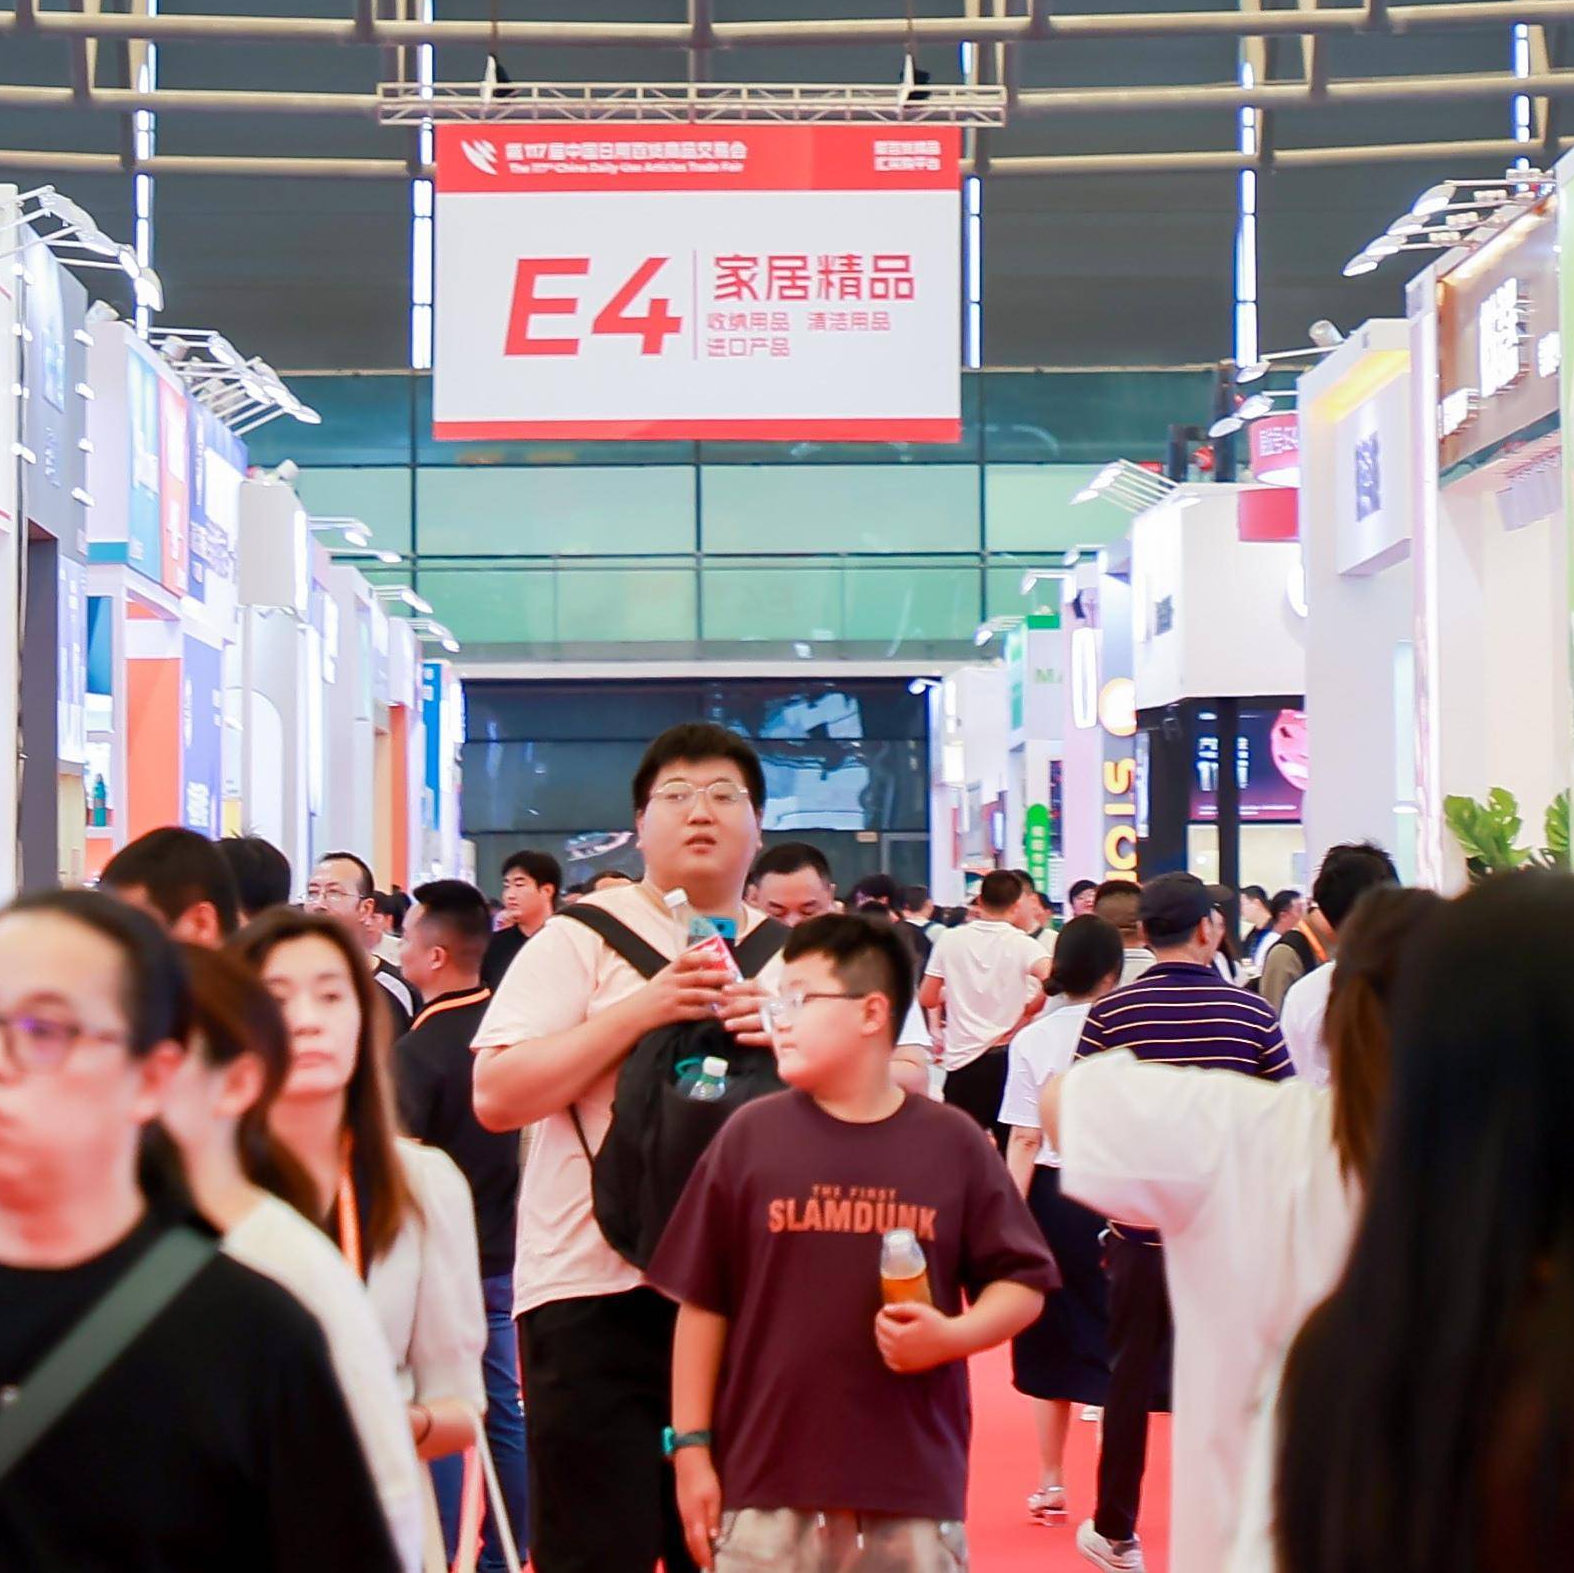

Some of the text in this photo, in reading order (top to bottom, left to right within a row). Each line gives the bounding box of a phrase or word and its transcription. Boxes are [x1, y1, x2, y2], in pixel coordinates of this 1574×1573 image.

[713, 254, 915, 301] 家居精品
[503, 257, 683, 357] E4
[807, 311, 891, 331] 清洁用品
[706, 336, 790, 358] 进口产品
